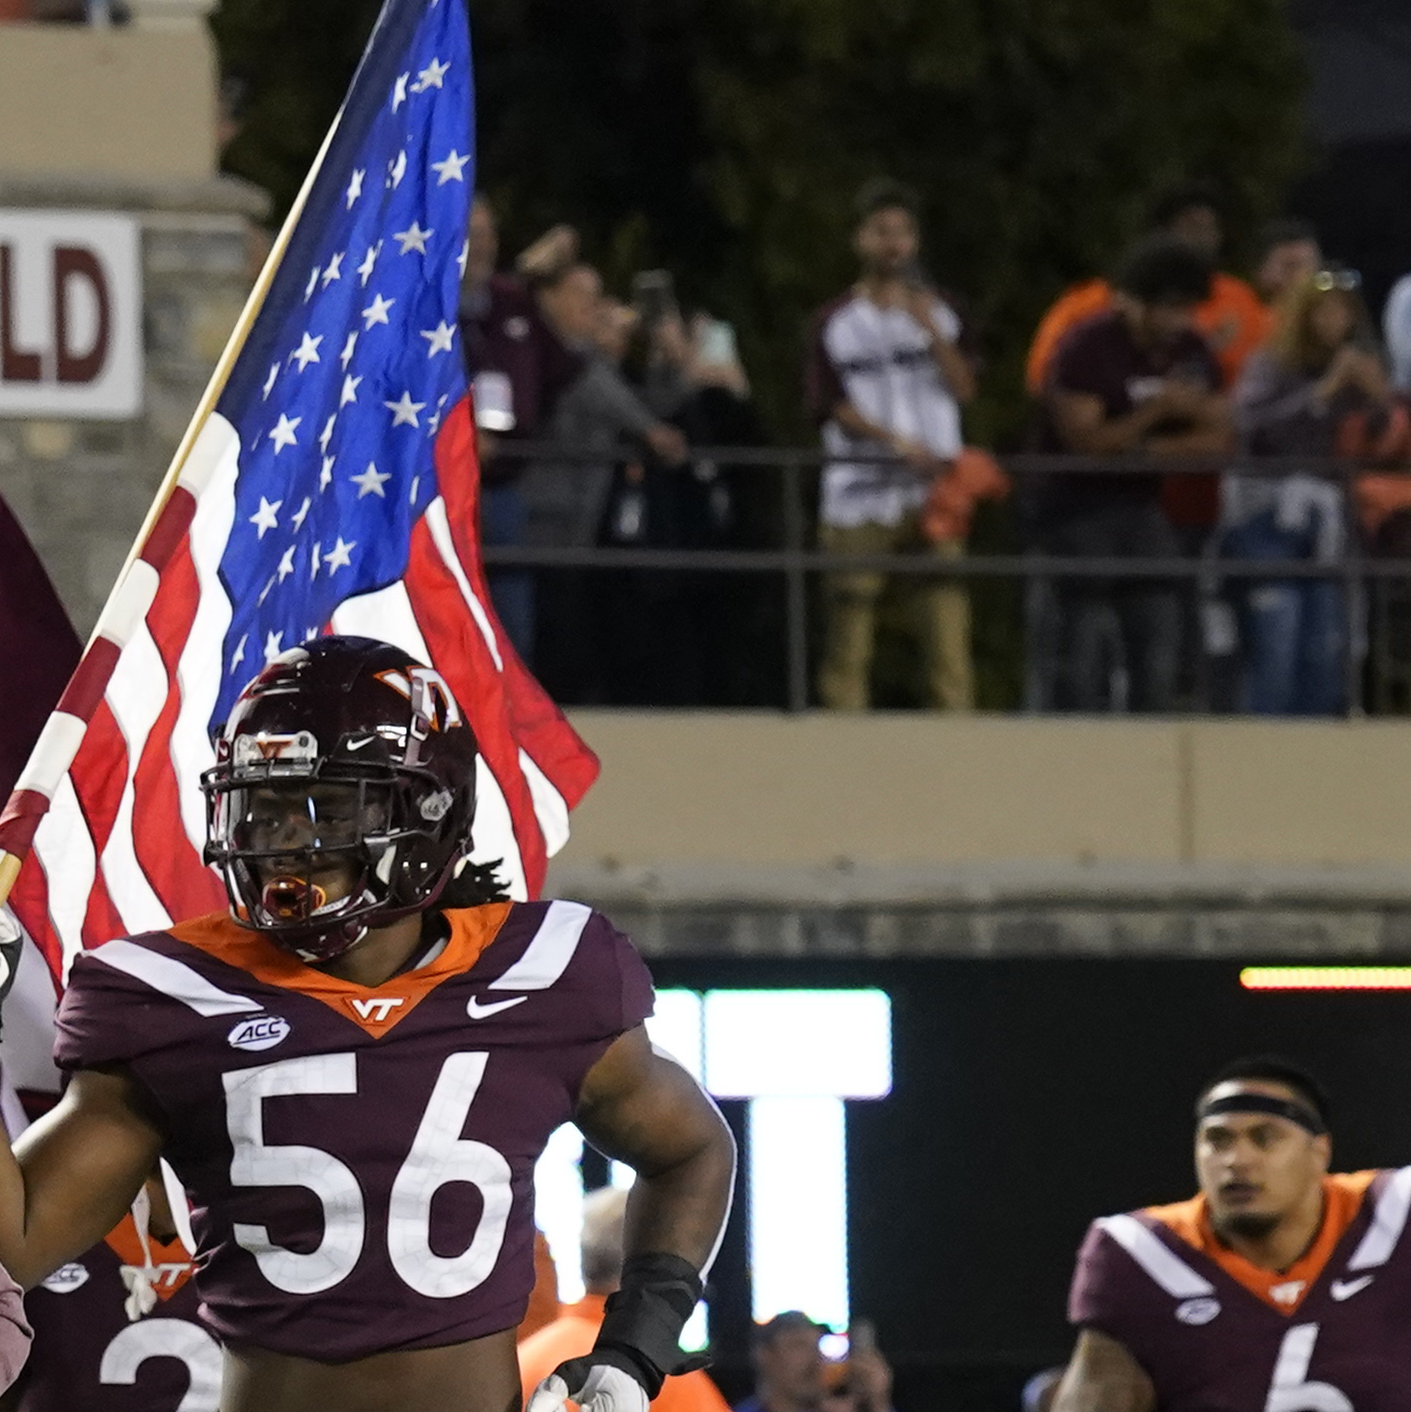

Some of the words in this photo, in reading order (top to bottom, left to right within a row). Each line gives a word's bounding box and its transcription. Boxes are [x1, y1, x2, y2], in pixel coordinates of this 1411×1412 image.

[351, 998, 404, 1021] VT
[237, 1020, 282, 1041] ACC
[221, 1051, 514, 1298] 56
